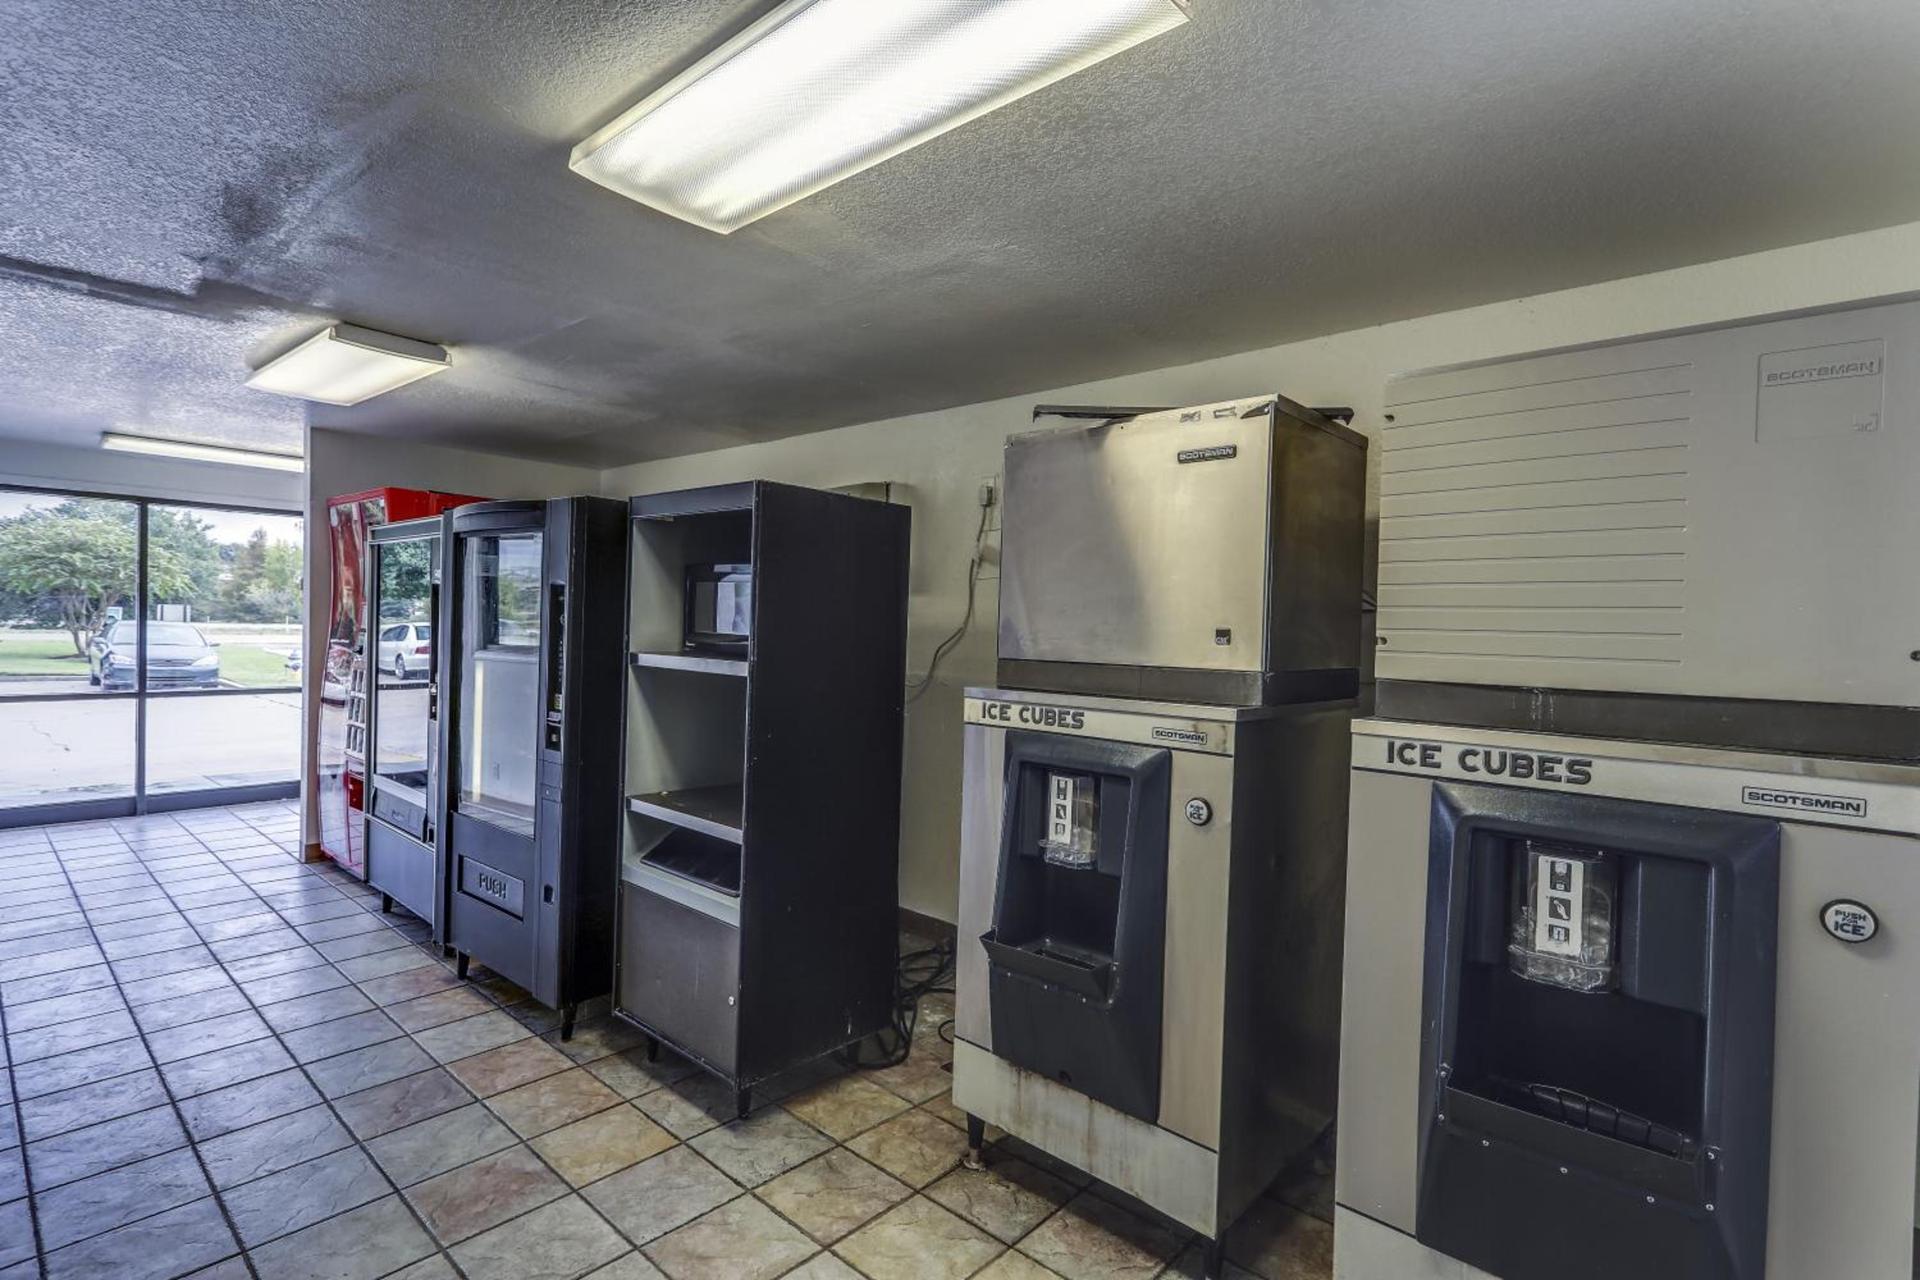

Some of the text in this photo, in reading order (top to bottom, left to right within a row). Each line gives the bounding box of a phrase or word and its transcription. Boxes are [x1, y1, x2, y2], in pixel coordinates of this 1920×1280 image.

[1766, 361, 1875, 383] SCOTSMAN
[1178, 446, 1235, 461] SCOTSMAN
[981, 702, 1085, 730] ICE CUBES
[1154, 729, 1206, 743] SCOTSMAN
[1386, 740, 1593, 785] ICE CUBES
[1746, 790, 1862, 814] SCOTSMAN
[479, 872, 507, 900] PUSH
[1834, 909, 1867, 922] PUSH
[1833, 920, 1866, 937] ICE
